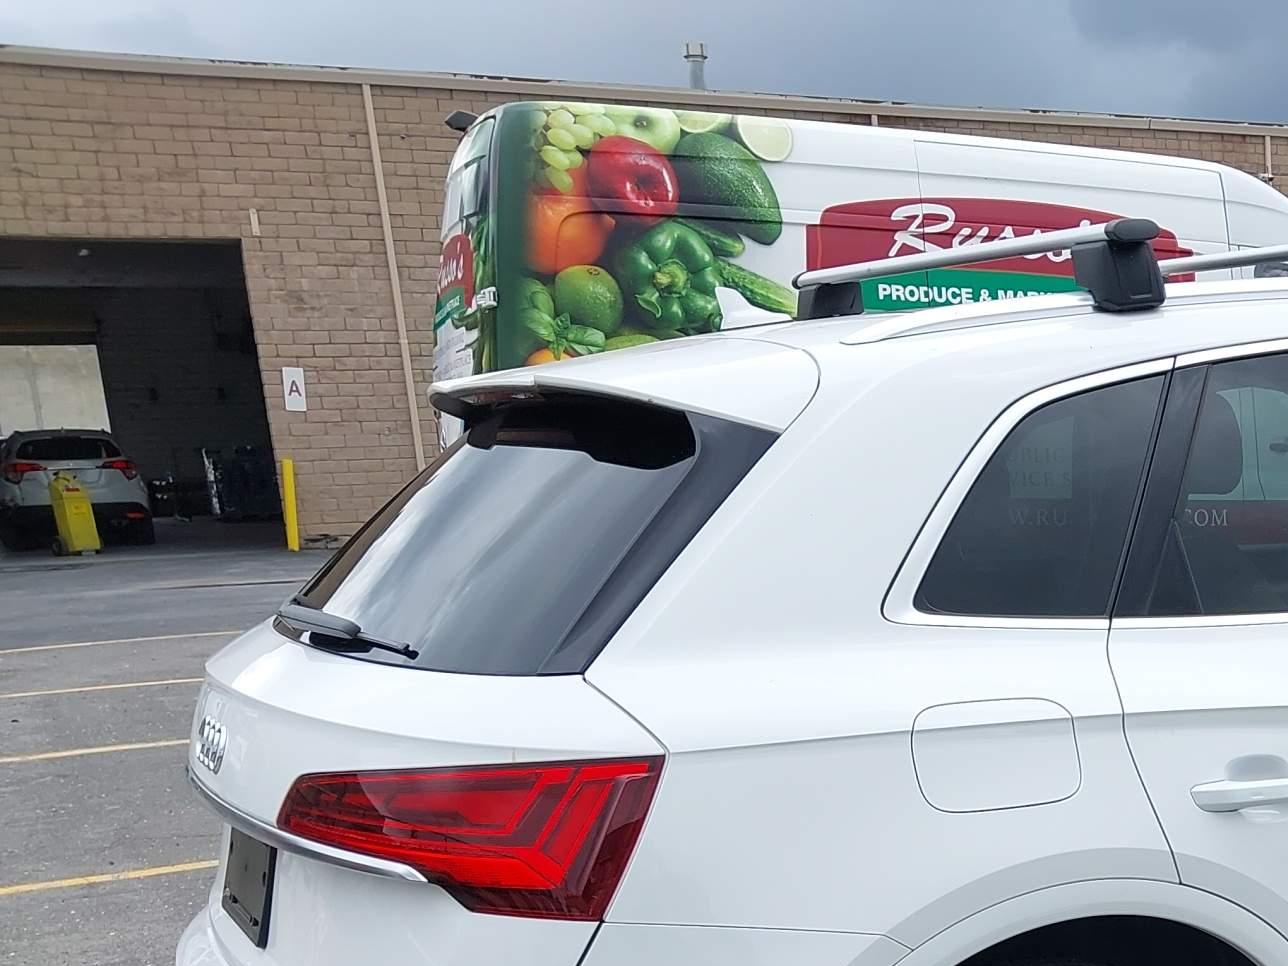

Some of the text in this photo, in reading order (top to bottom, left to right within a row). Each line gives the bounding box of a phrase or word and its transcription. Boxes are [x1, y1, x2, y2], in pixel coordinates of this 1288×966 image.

[877, 283, 974, 304] PRODUCE
[979, 289, 992, 302] &
[288, 379, 302, 397] A
